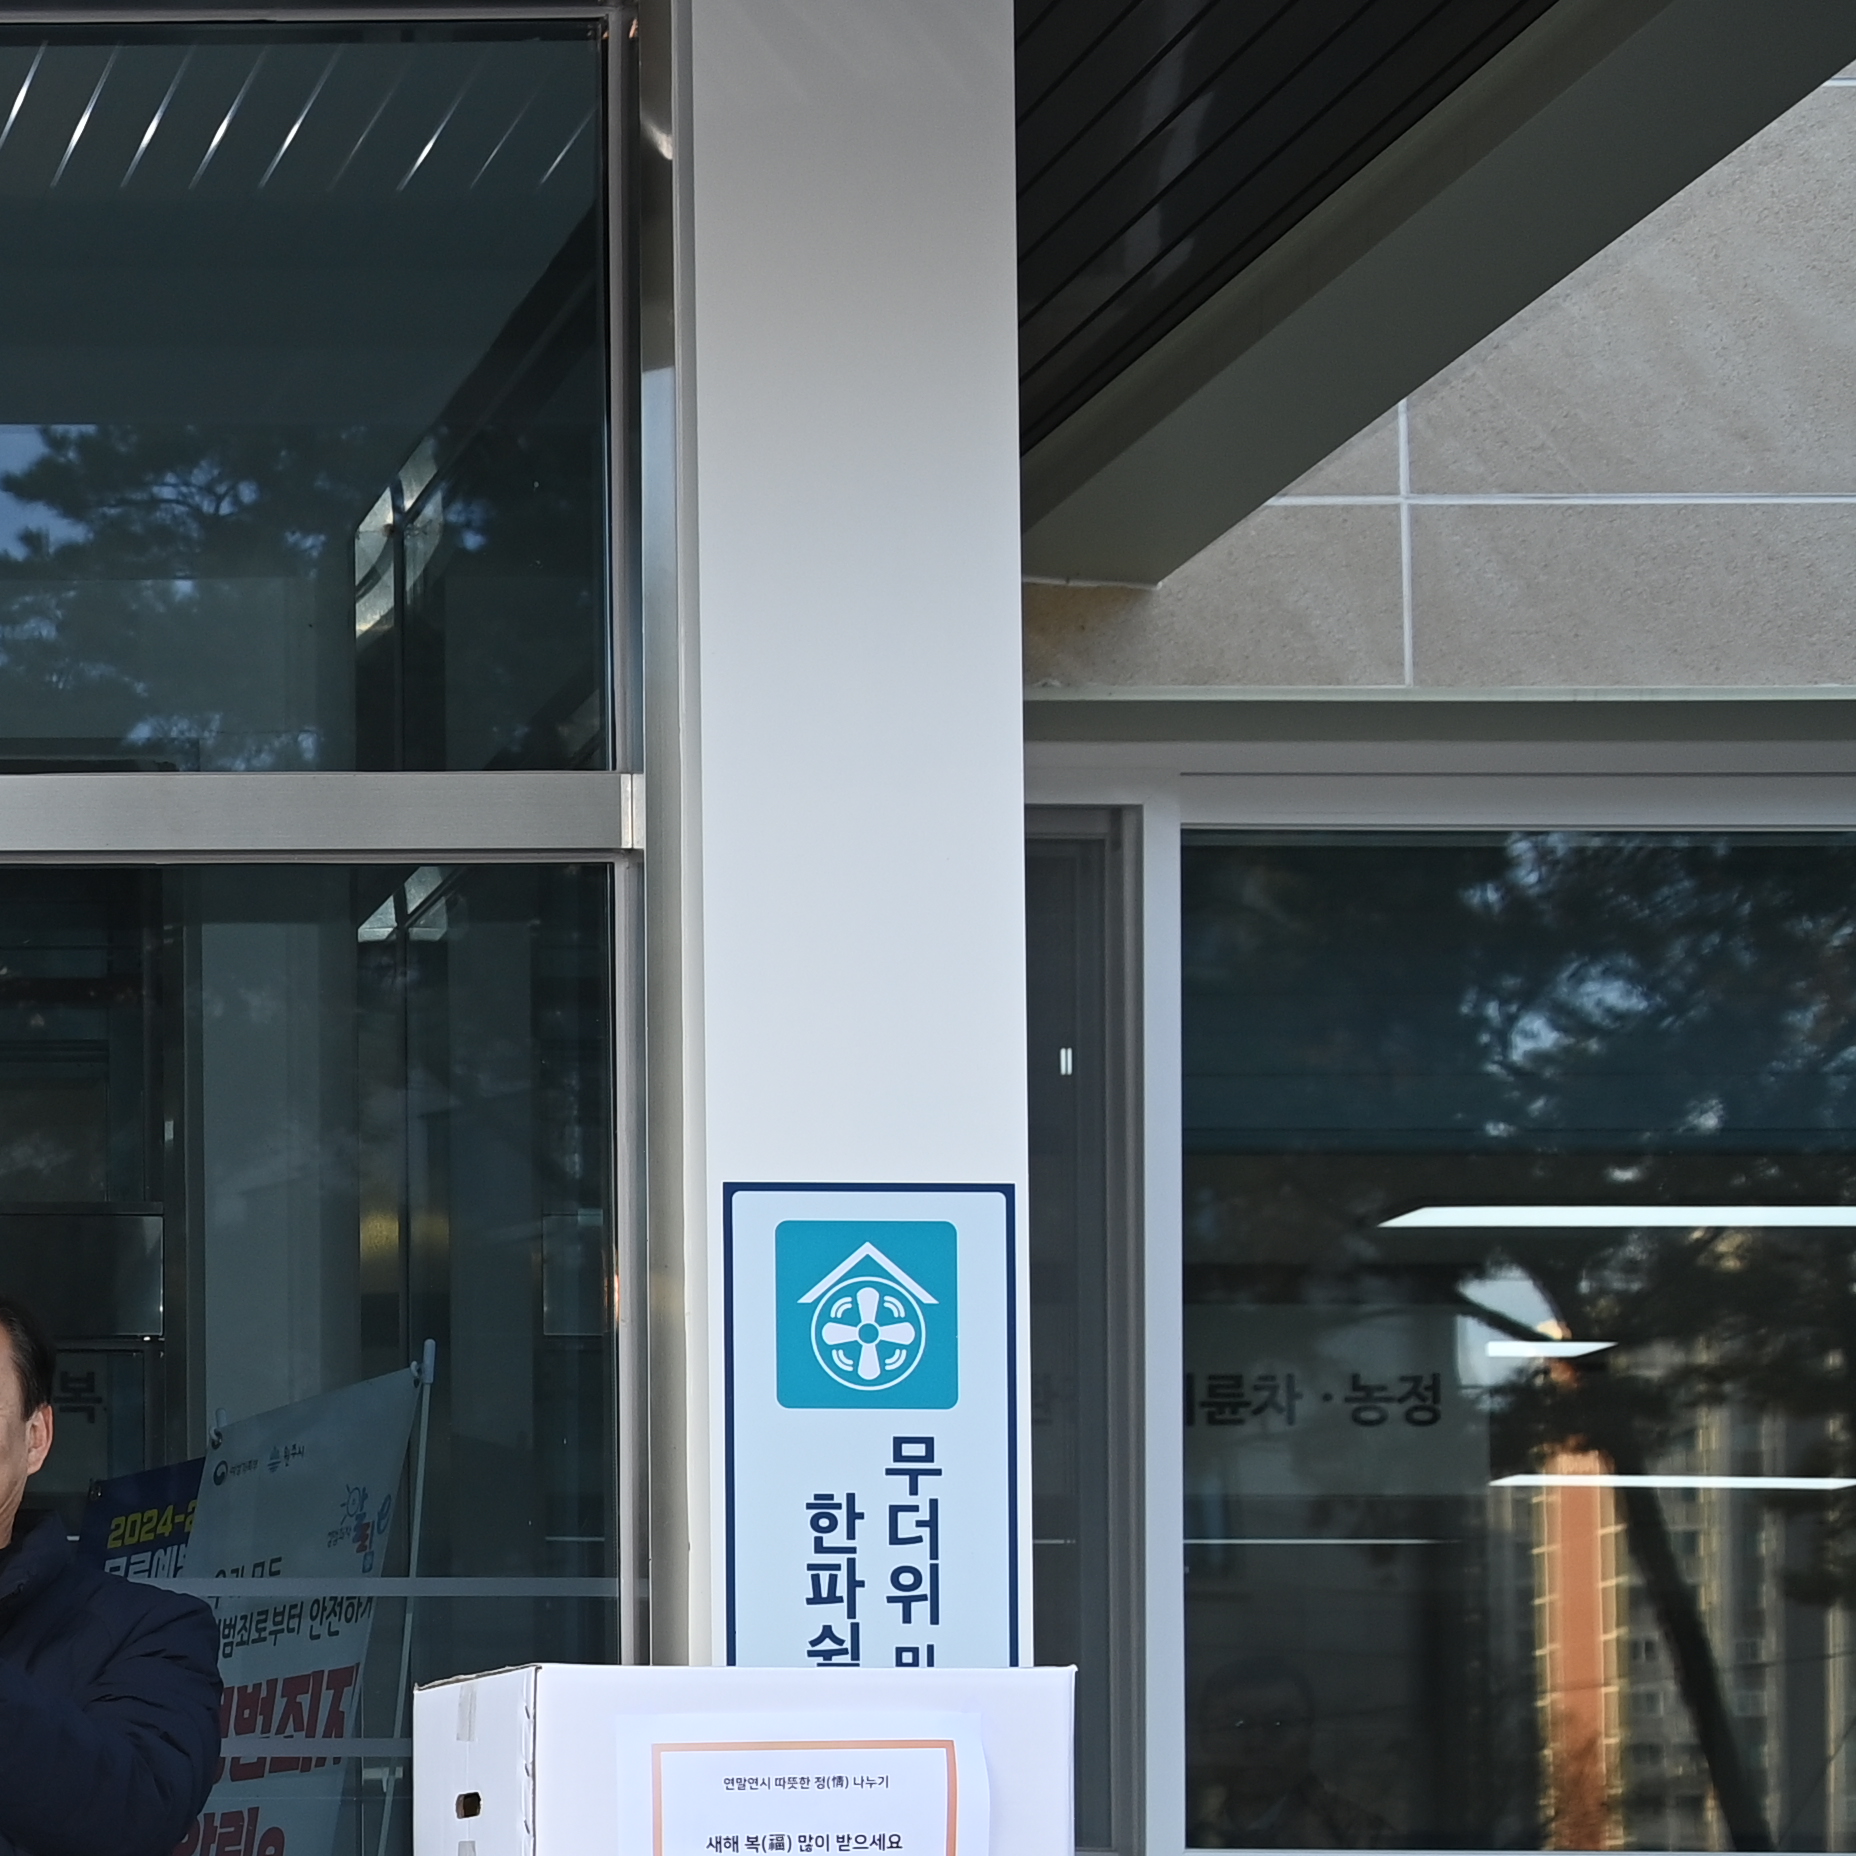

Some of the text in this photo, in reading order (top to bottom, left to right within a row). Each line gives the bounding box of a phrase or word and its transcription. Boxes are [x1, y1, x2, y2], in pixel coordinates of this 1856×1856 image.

[885, 1435, 943, 1625] 무더위
[723, 1776, 771, 1791] 연말연시
[774, 1776, 811, 1790] 따뜻한
[852, 1774, 889, 1790] 나누기
[705, 1834, 740, 1854] 새해
[797, 1833, 830, 1853] 많이
[835, 1832, 904, 1853] 받으세요
